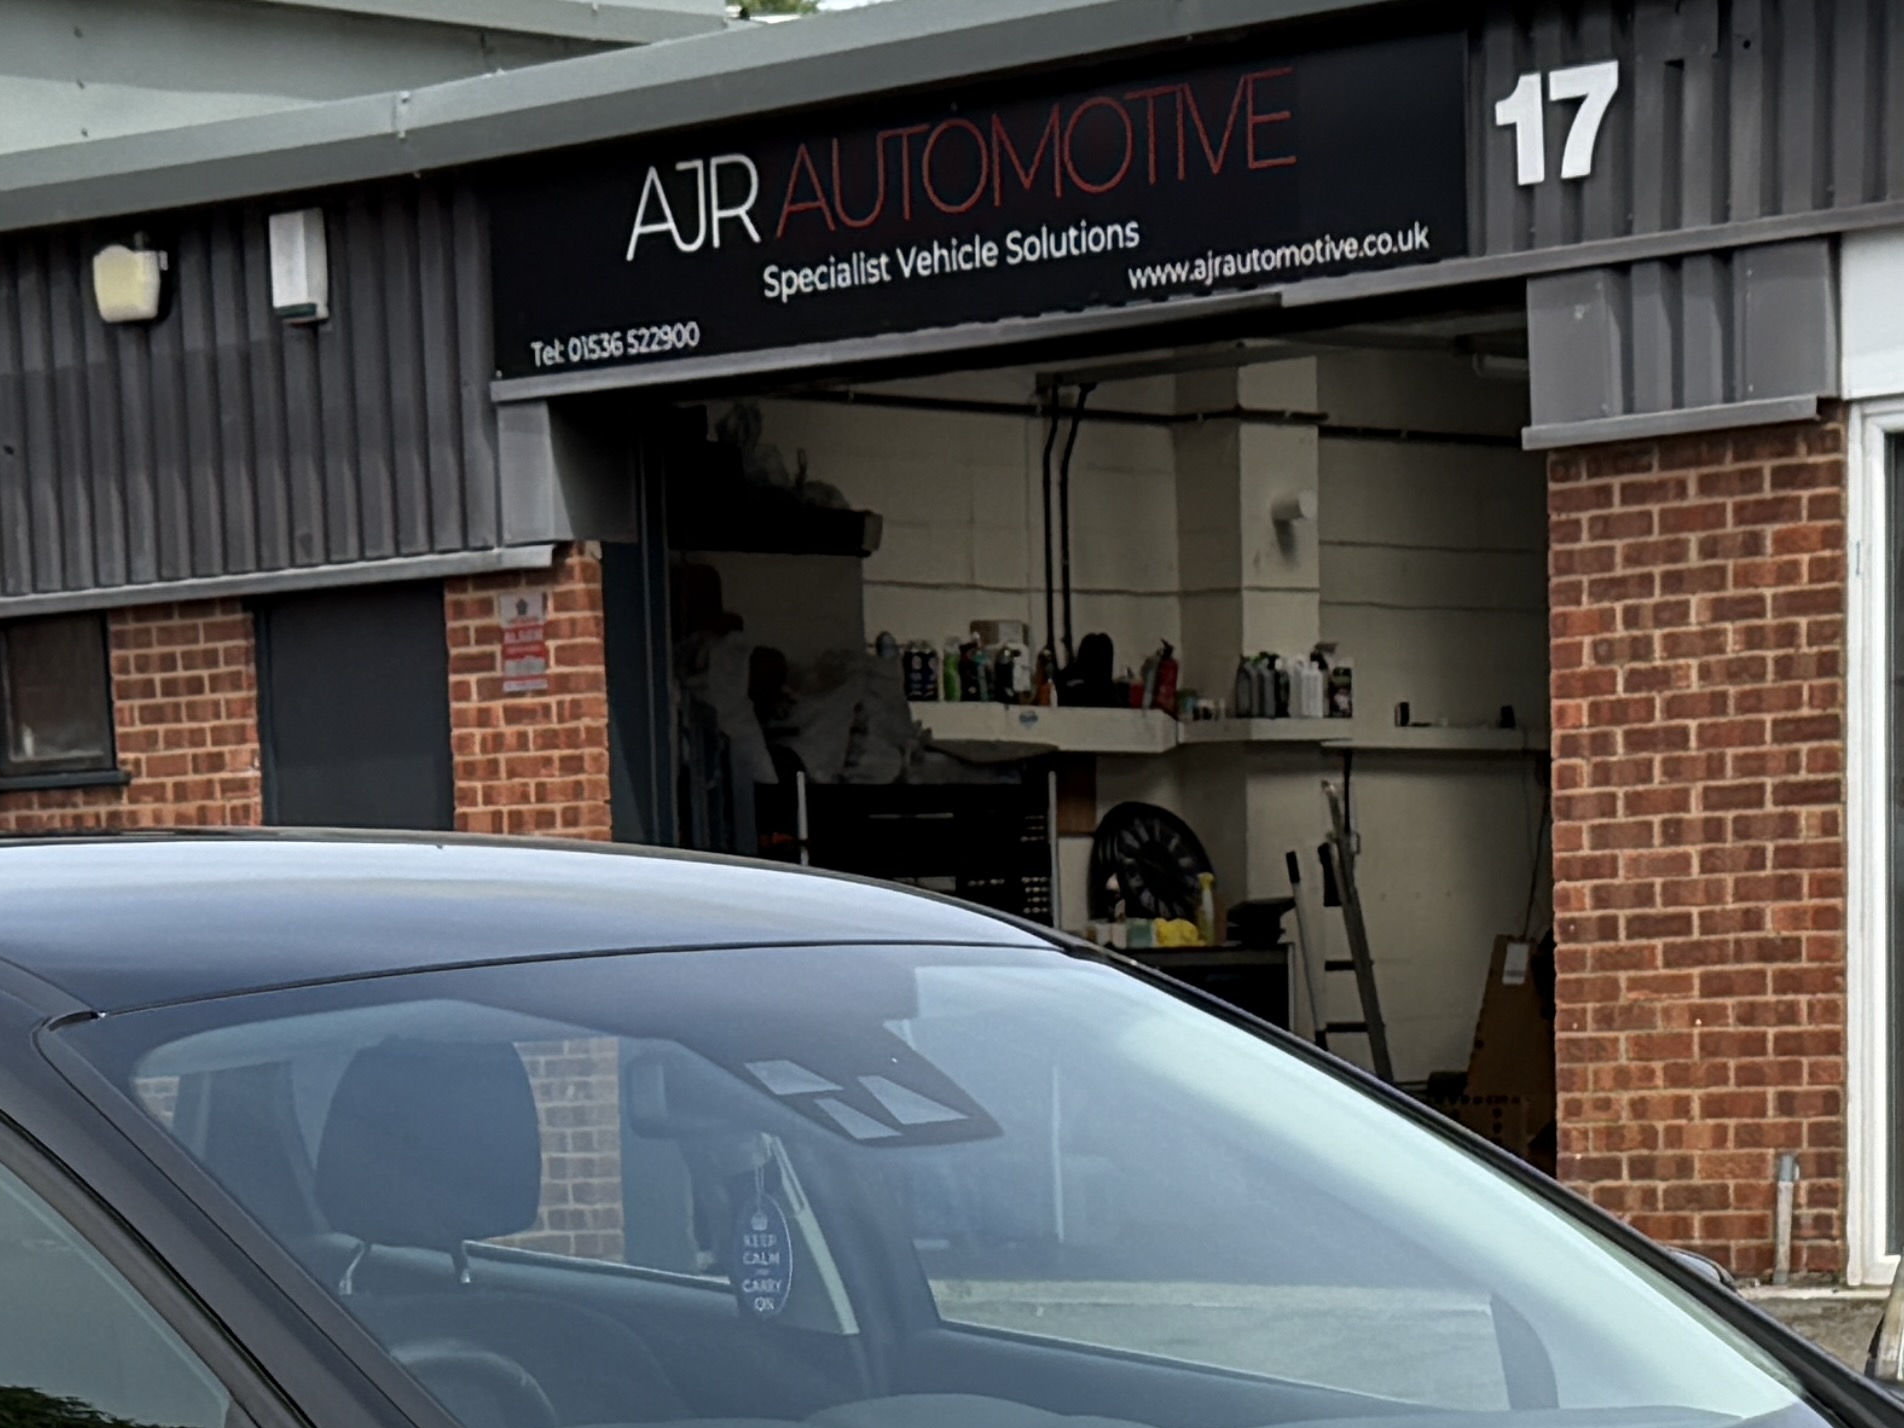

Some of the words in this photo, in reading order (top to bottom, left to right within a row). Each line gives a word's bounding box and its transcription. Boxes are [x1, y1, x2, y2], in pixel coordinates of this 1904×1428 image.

[625, 152, 762, 262] AJR
[775, 65, 1297, 240] AUTOMOTIVE
[1495, 59, 1619, 186] 17
[762, 248, 891, 303] Specialist
[896, 232, 999, 279] Vehicle
[1005, 217, 1141, 267] Solutions
[1127, 220, 1431, 290] www.ajrautomotive.co.uk
[530, 337, 565, 367] Tel:
[567, 330, 624, 363] 01536
[626, 320, 701, 355] 522900
